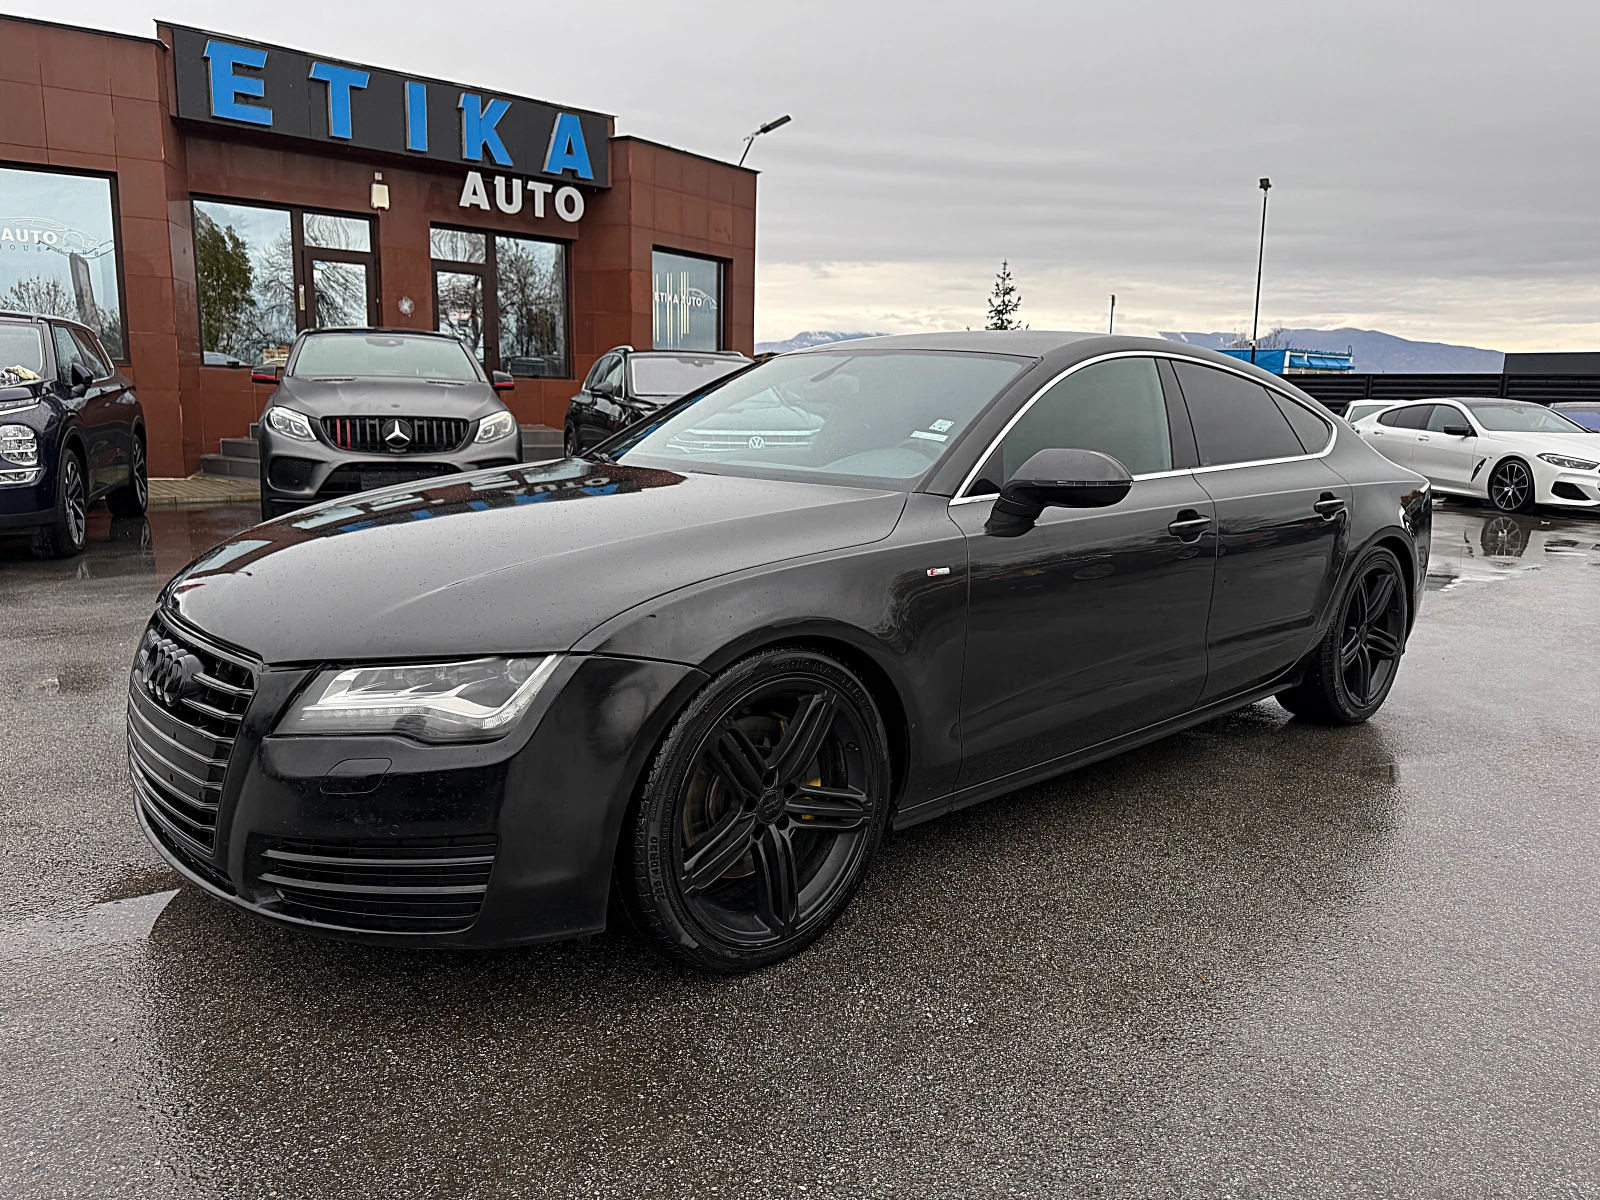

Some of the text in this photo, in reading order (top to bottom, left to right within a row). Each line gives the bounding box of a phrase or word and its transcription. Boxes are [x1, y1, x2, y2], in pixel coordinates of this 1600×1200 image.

[203, 39, 594, 180] ETIKA
[459, 171, 586, 223] AUTO
[1, 227, 58, 245] AUTO
